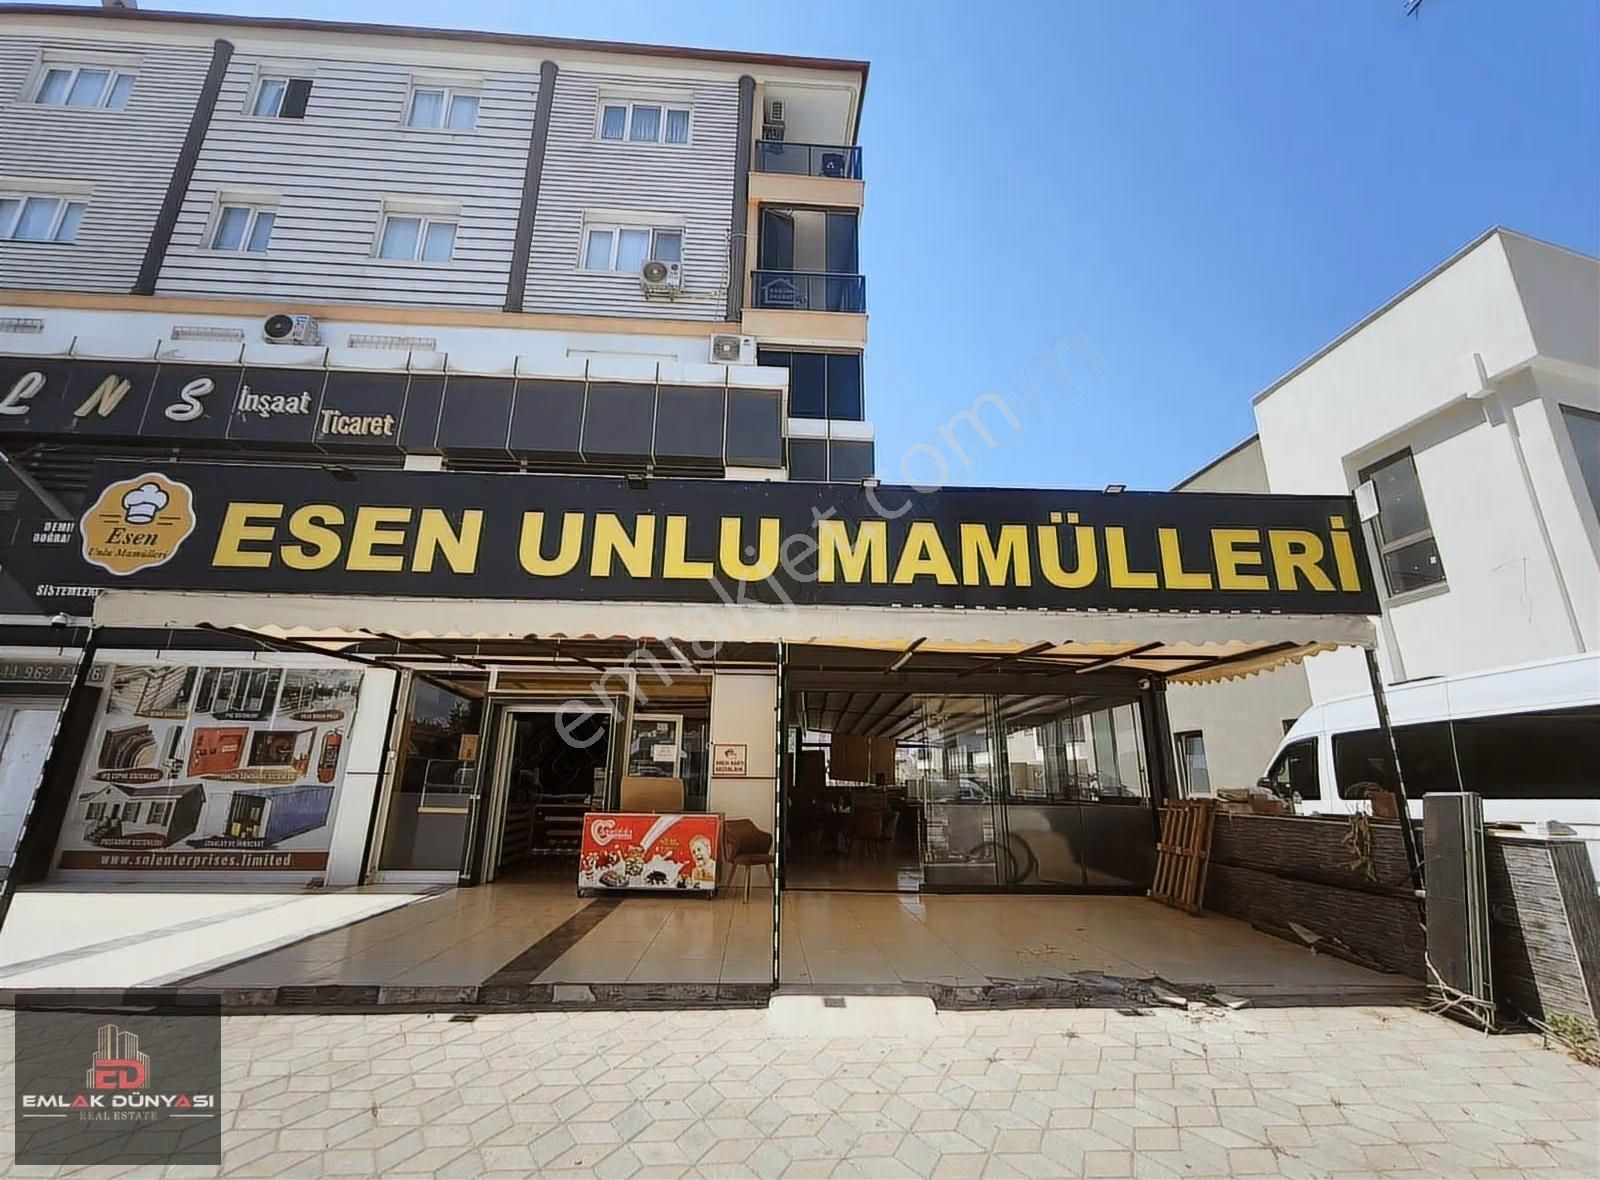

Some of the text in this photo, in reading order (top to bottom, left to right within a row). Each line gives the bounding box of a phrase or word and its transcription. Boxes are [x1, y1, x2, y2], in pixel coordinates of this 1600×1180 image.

[237, 385, 312, 418] İnşaat
[321, 409, 395, 436] Ticaret
[104, 527, 159, 545] Esen
[211, 502, 1362, 593] ESEN UNLU MAMÜLLERİ
